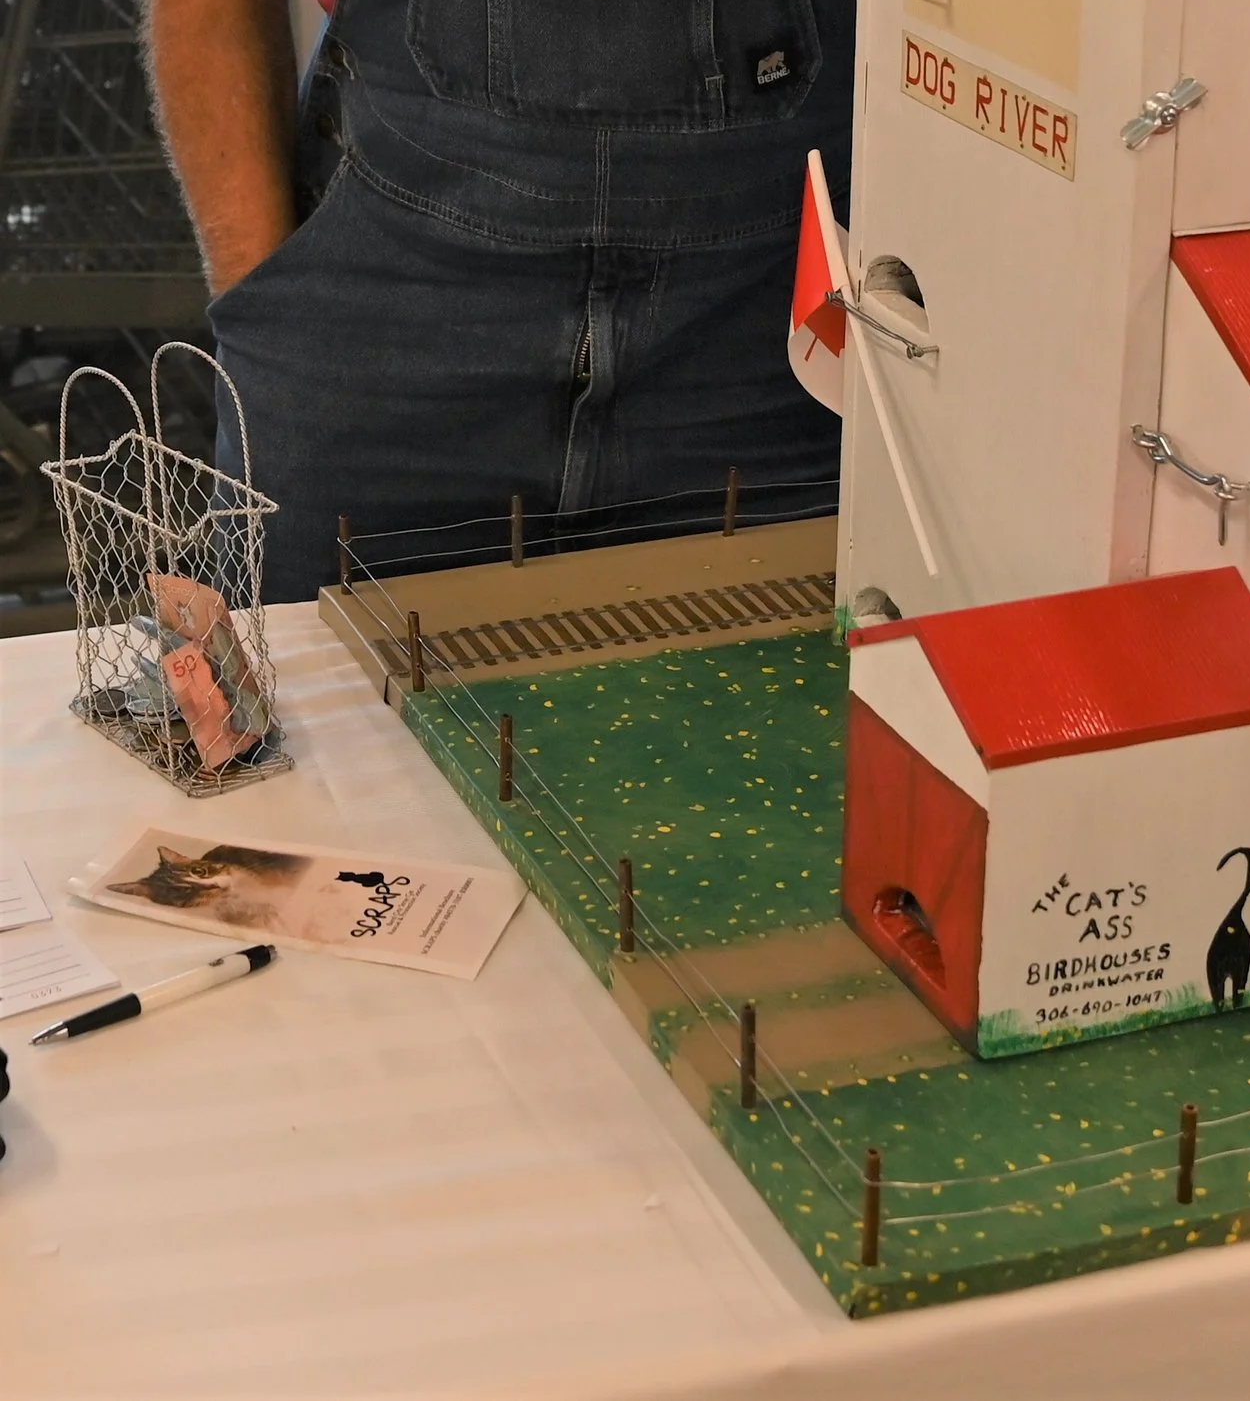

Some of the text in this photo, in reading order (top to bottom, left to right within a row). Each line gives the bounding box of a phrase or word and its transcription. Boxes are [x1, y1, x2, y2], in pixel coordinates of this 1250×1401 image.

[757, 66, 788, 85] BERNE
[905, 36, 1069, 164] DOG RIVER
[172, 654, 198, 678] 50
[350, 875, 410, 938] SCRAPS
[1031, 872, 1071, 914] THE
[1065, 882, 1148, 917] CAT'S
[1079, 914, 1133, 943] ASS
[1026, 943, 1172, 985] BIRDHOUSES
[1049, 968, 1164, 997] DRINKWATER
[1035, 990, 1163, 1025] 306-690-1047
